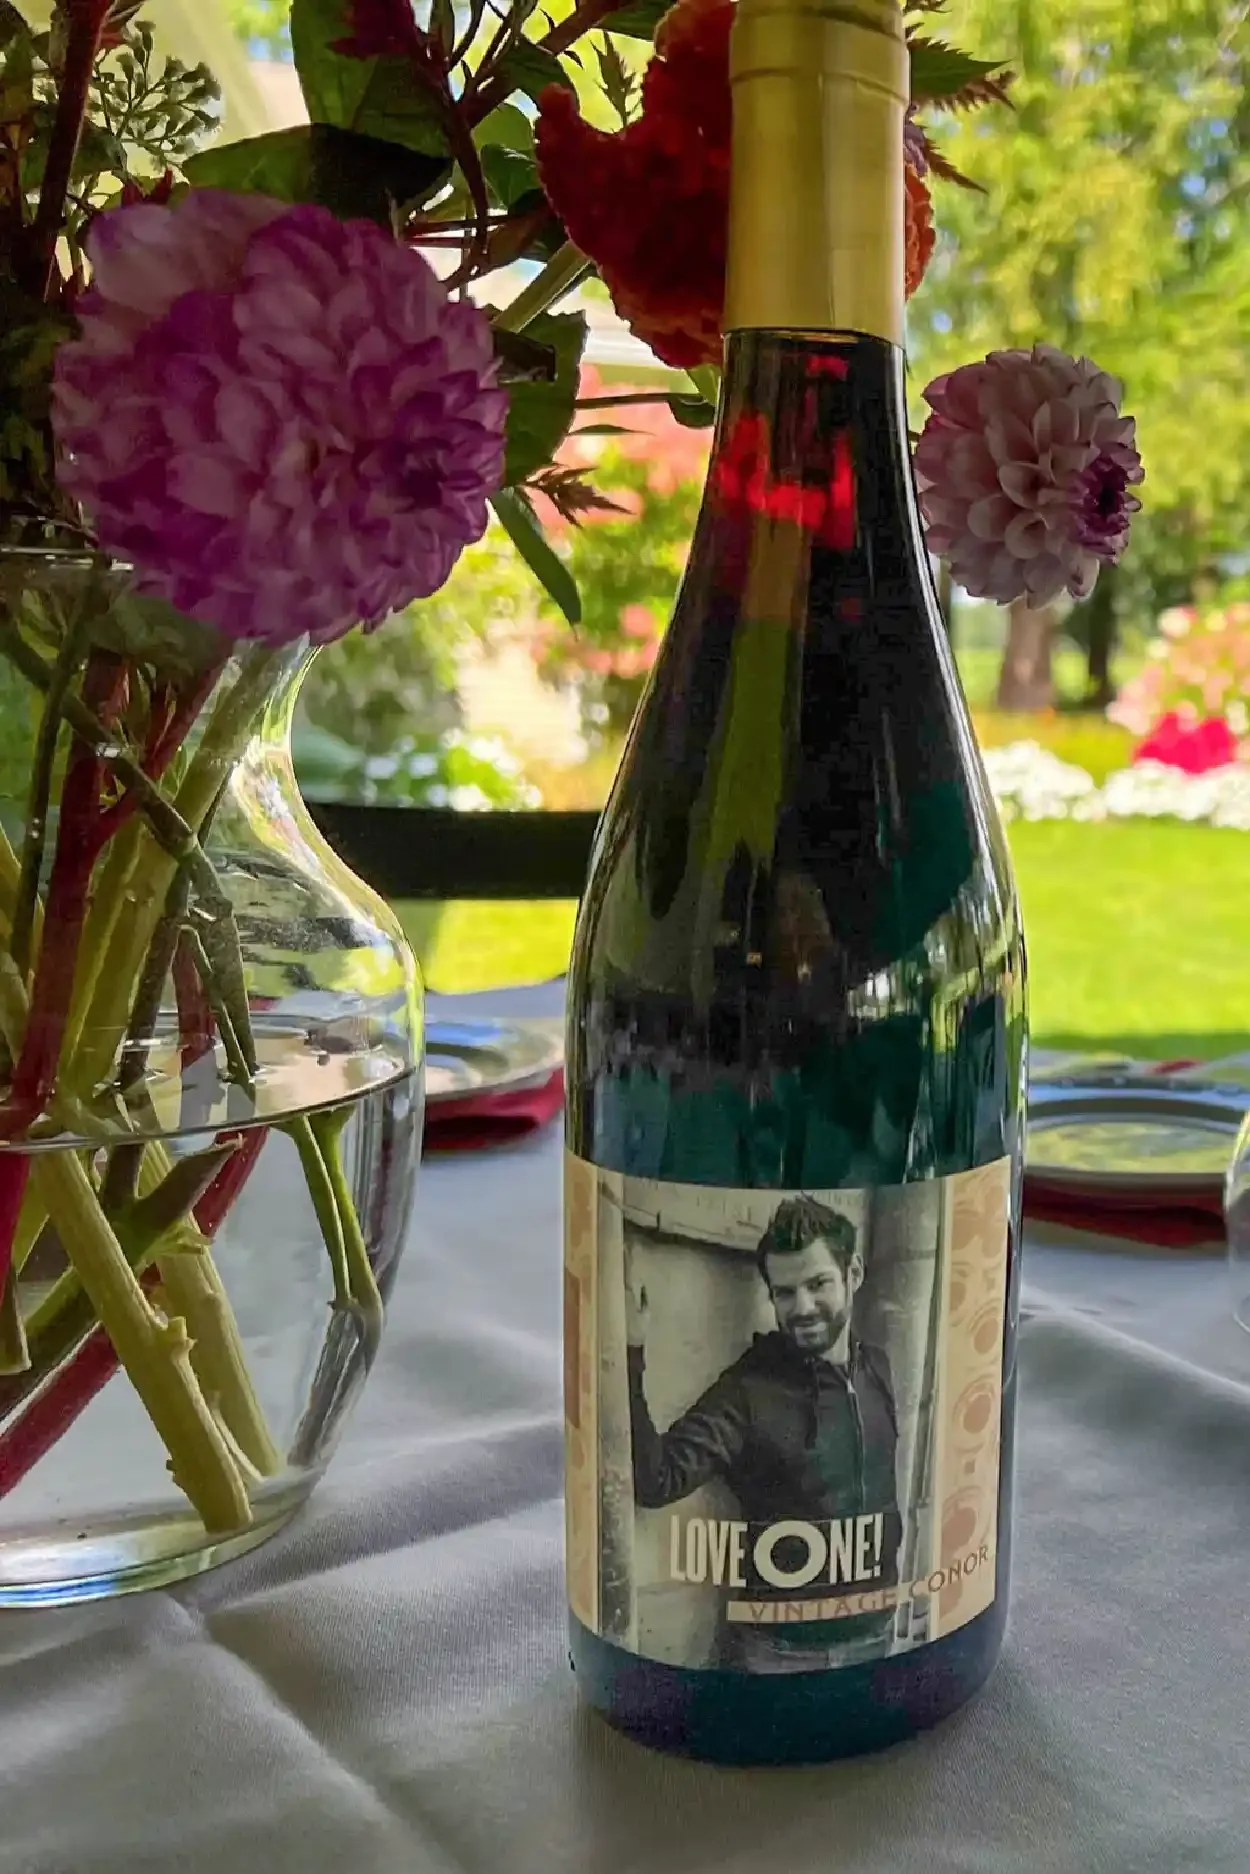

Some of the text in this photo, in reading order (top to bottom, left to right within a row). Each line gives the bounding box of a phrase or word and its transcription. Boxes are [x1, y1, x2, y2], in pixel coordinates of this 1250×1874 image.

[669, 1511, 884, 1589] LOVE ONE!
[749, 1543, 989, 1623] VINTAGE CONOR
